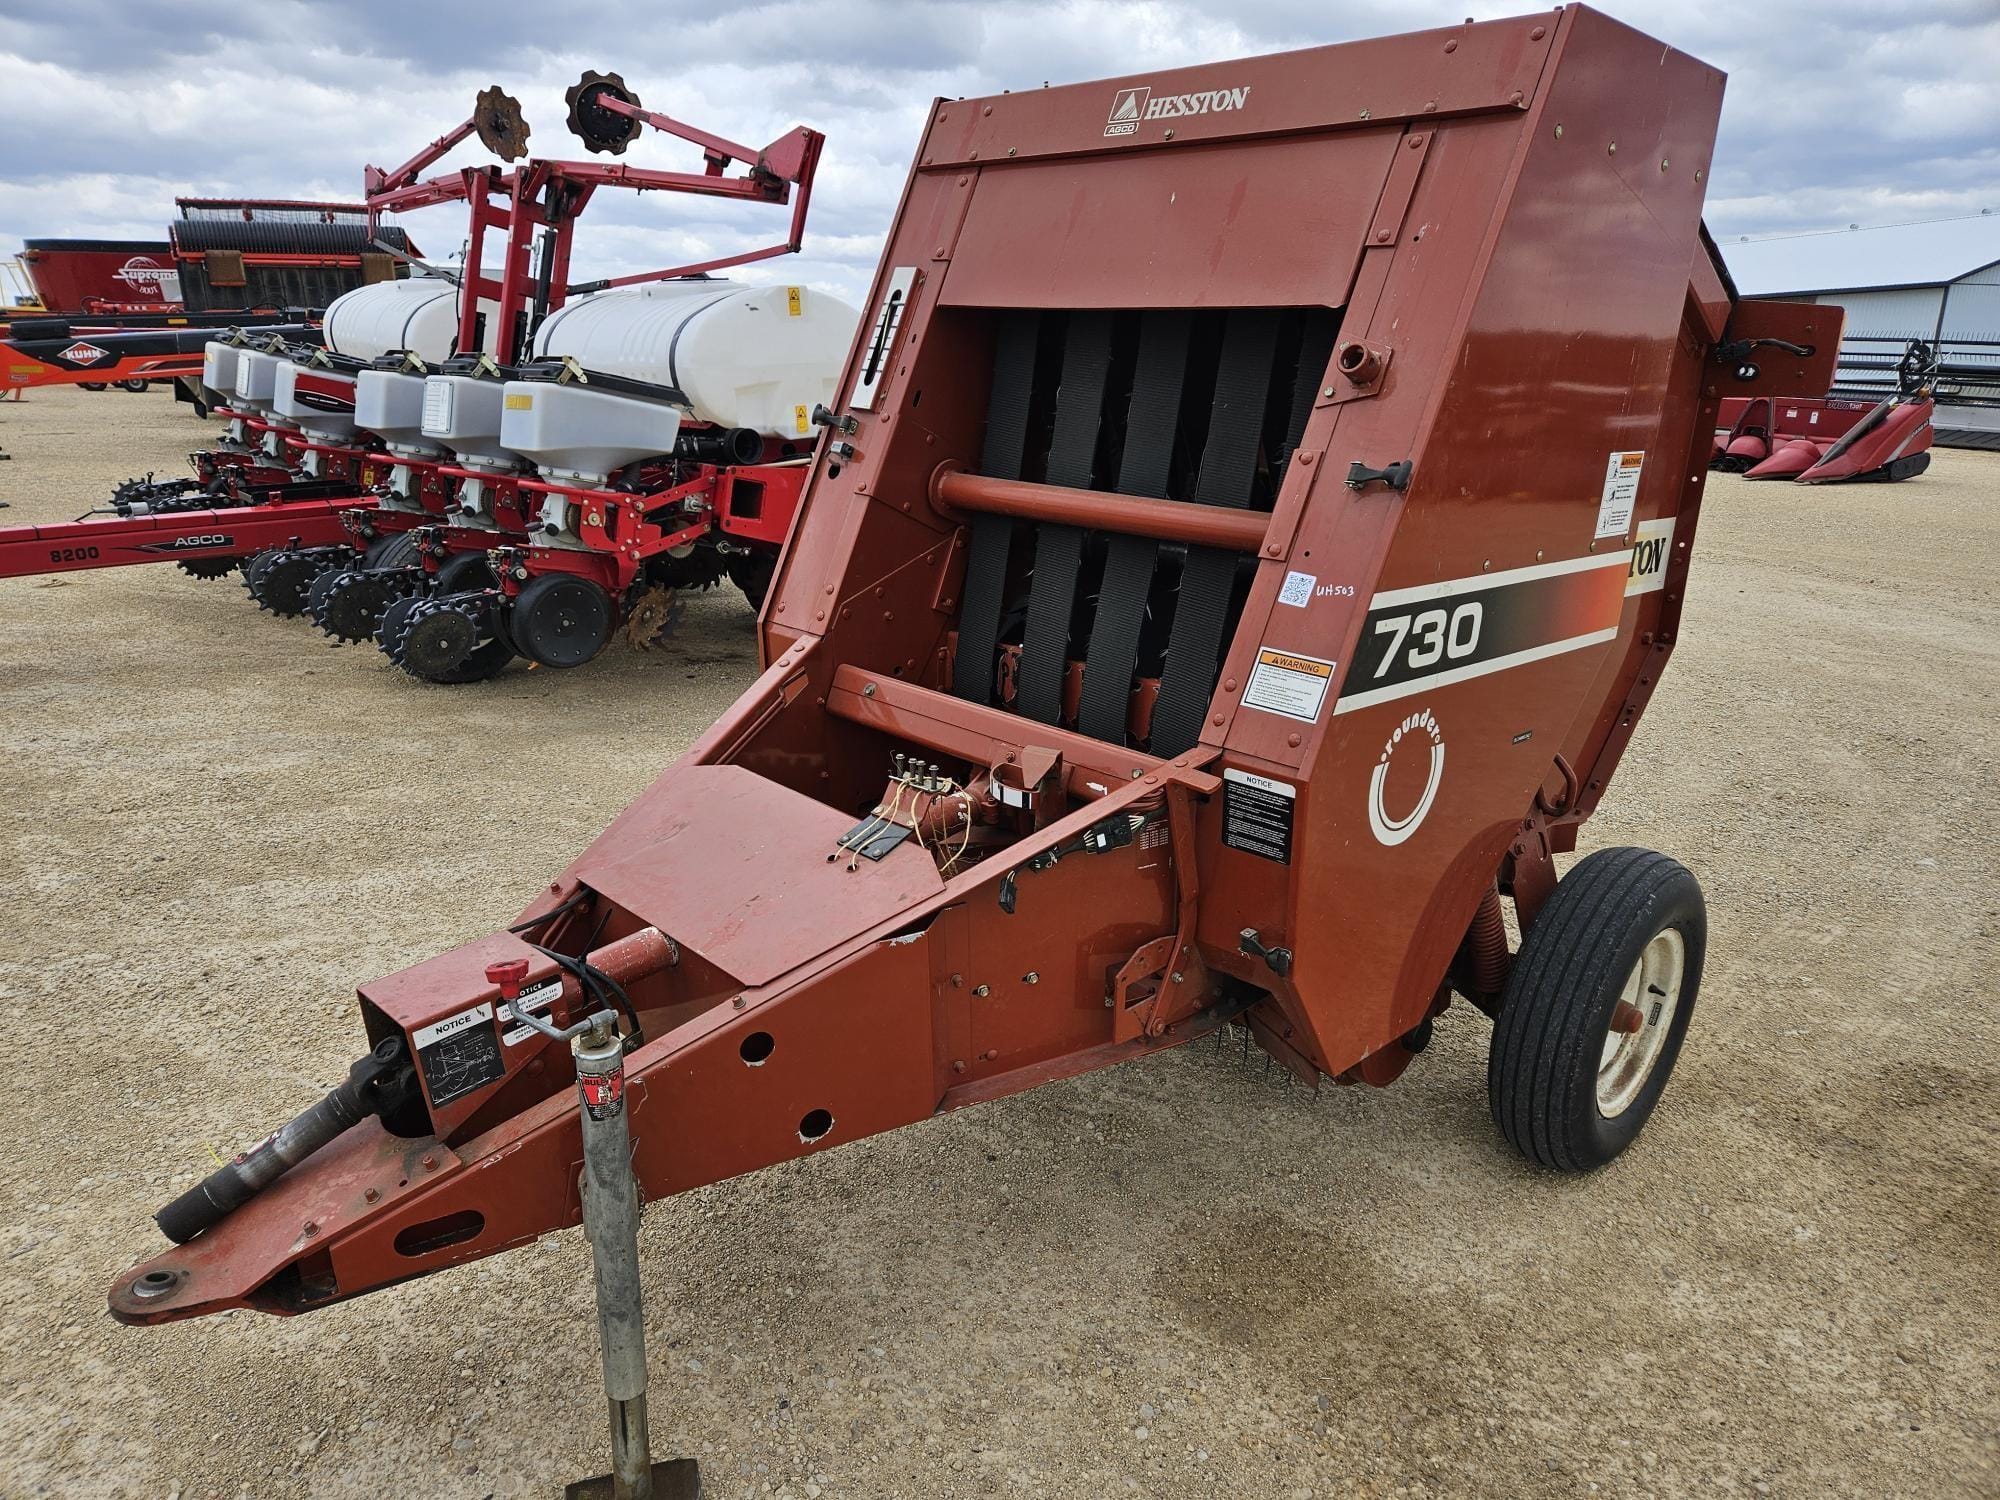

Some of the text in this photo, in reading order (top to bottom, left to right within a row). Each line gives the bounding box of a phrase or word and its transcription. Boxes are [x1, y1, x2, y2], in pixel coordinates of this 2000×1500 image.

[1144, 87, 1251, 120] HESSTON
[1108, 126, 1135, 134] AGCO
[66, 350, 101, 360] KUHN
[174, 534, 225, 547] AGCO
[51, 546, 100, 563] 8200
[1316, 584, 1354, 597] UH503
[1373, 601, 1483, 679] 730
[1279, 656, 1320, 674] WARNING
[1246, 776, 1273, 789] NOTICE
[519, 983, 542, 997] OTICE
[435, 1014, 472, 1035] NOTICE
